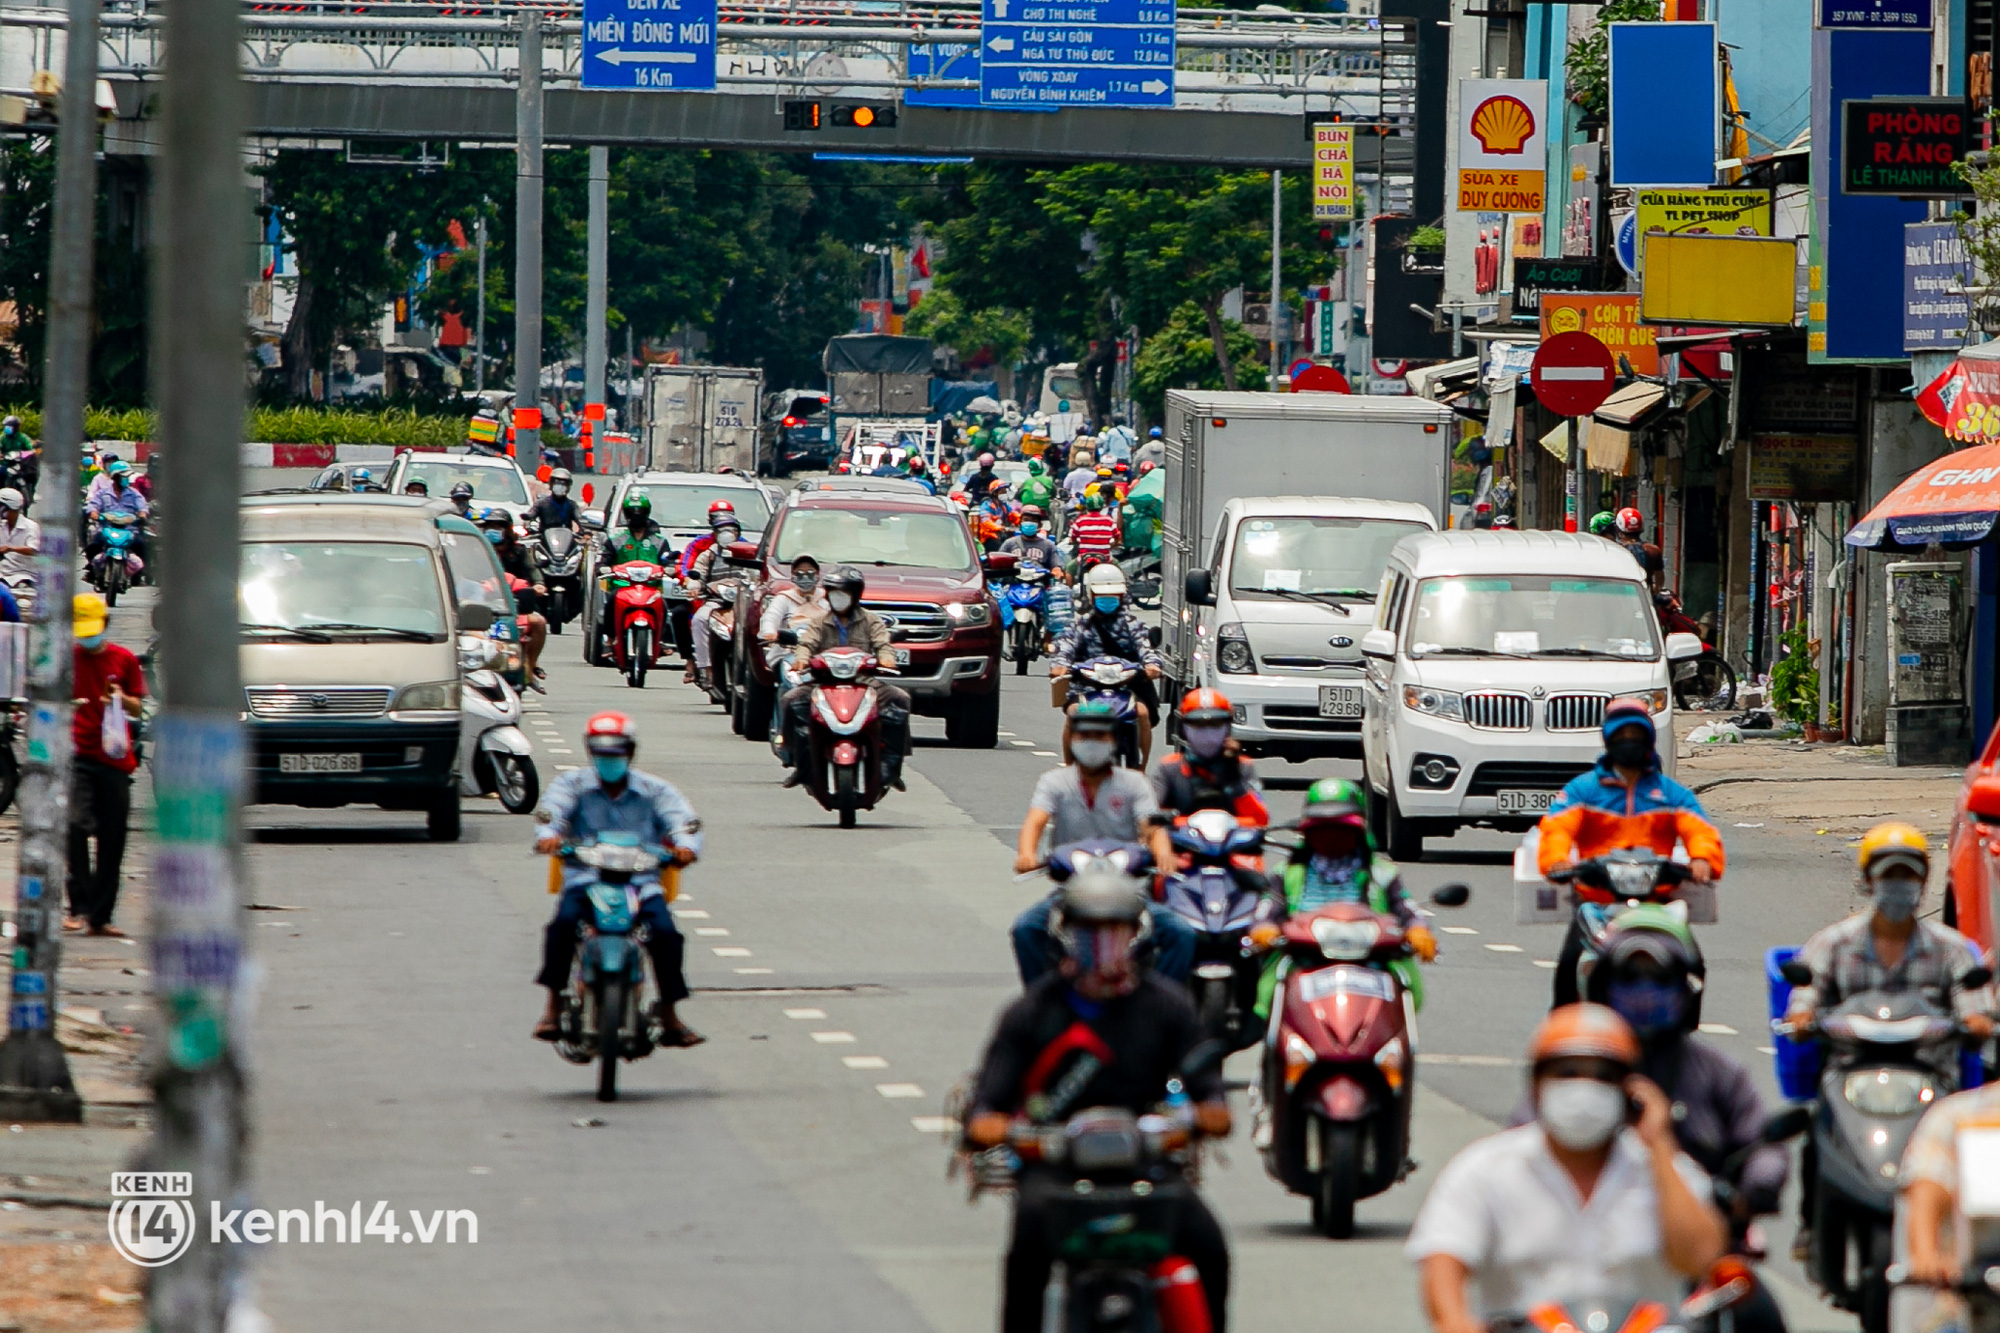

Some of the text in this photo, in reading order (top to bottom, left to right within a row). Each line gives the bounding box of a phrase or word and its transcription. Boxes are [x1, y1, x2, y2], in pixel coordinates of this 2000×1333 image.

[1154, 11, 1170, 22] Km
[588, 13, 710, 44] MIỀN ĐÔNG MỚI
[1047, 29, 1066, 43] SÀI
[1069, 29, 1093, 44] GÒN
[1154, 34, 1170, 45] Km
[1066, 47, 1088, 61] THỦ
[1091, 48, 1115, 62] ĐỨC
[1153, 51, 1169, 62] Km
[635, 67, 673, 86] 16 Km
[1018, 70, 1049, 83] VÒNG
[1124, 82, 1139, 93] Km
[1867, 107, 1961, 135] PHÒNG
[1318, 129, 1349, 142] BÚN
[1318, 146, 1348, 160] CHẢ
[1873, 137, 1953, 164] RĂNG
[1323, 165, 1343, 179] HÀ
[1463, 170, 1519, 186] SỬA XE
[1853, 165, 1873, 185] LÊ
[1319, 184, 1347, 199] NỘI
[1462, 190, 1489, 208] DUY
[1641, 191, 1665, 206] CỬA
[1667, 193, 1701, 206] HÀNG
[1703, 192, 1729, 206] THÚ
[1682, 210, 1705, 221] PET
[1707, 210, 1740, 222] SHOP
[1525, 264, 1547, 281] Áo
[1594, 303, 1620, 323] CƠM
[1629, 327, 1656, 346] QUE
[1754, 436, 1787, 450] Ngọc
[1790, 437, 1813, 449] Lan
[1928, 466, 2000, 486] GHN
[1896, 520, 1992, 535] GIAO HÀNG NHANH TOÀN QUỐC
[1330, 688, 1352, 700] 51D
[1321, 702, 1360, 716] 429.68
